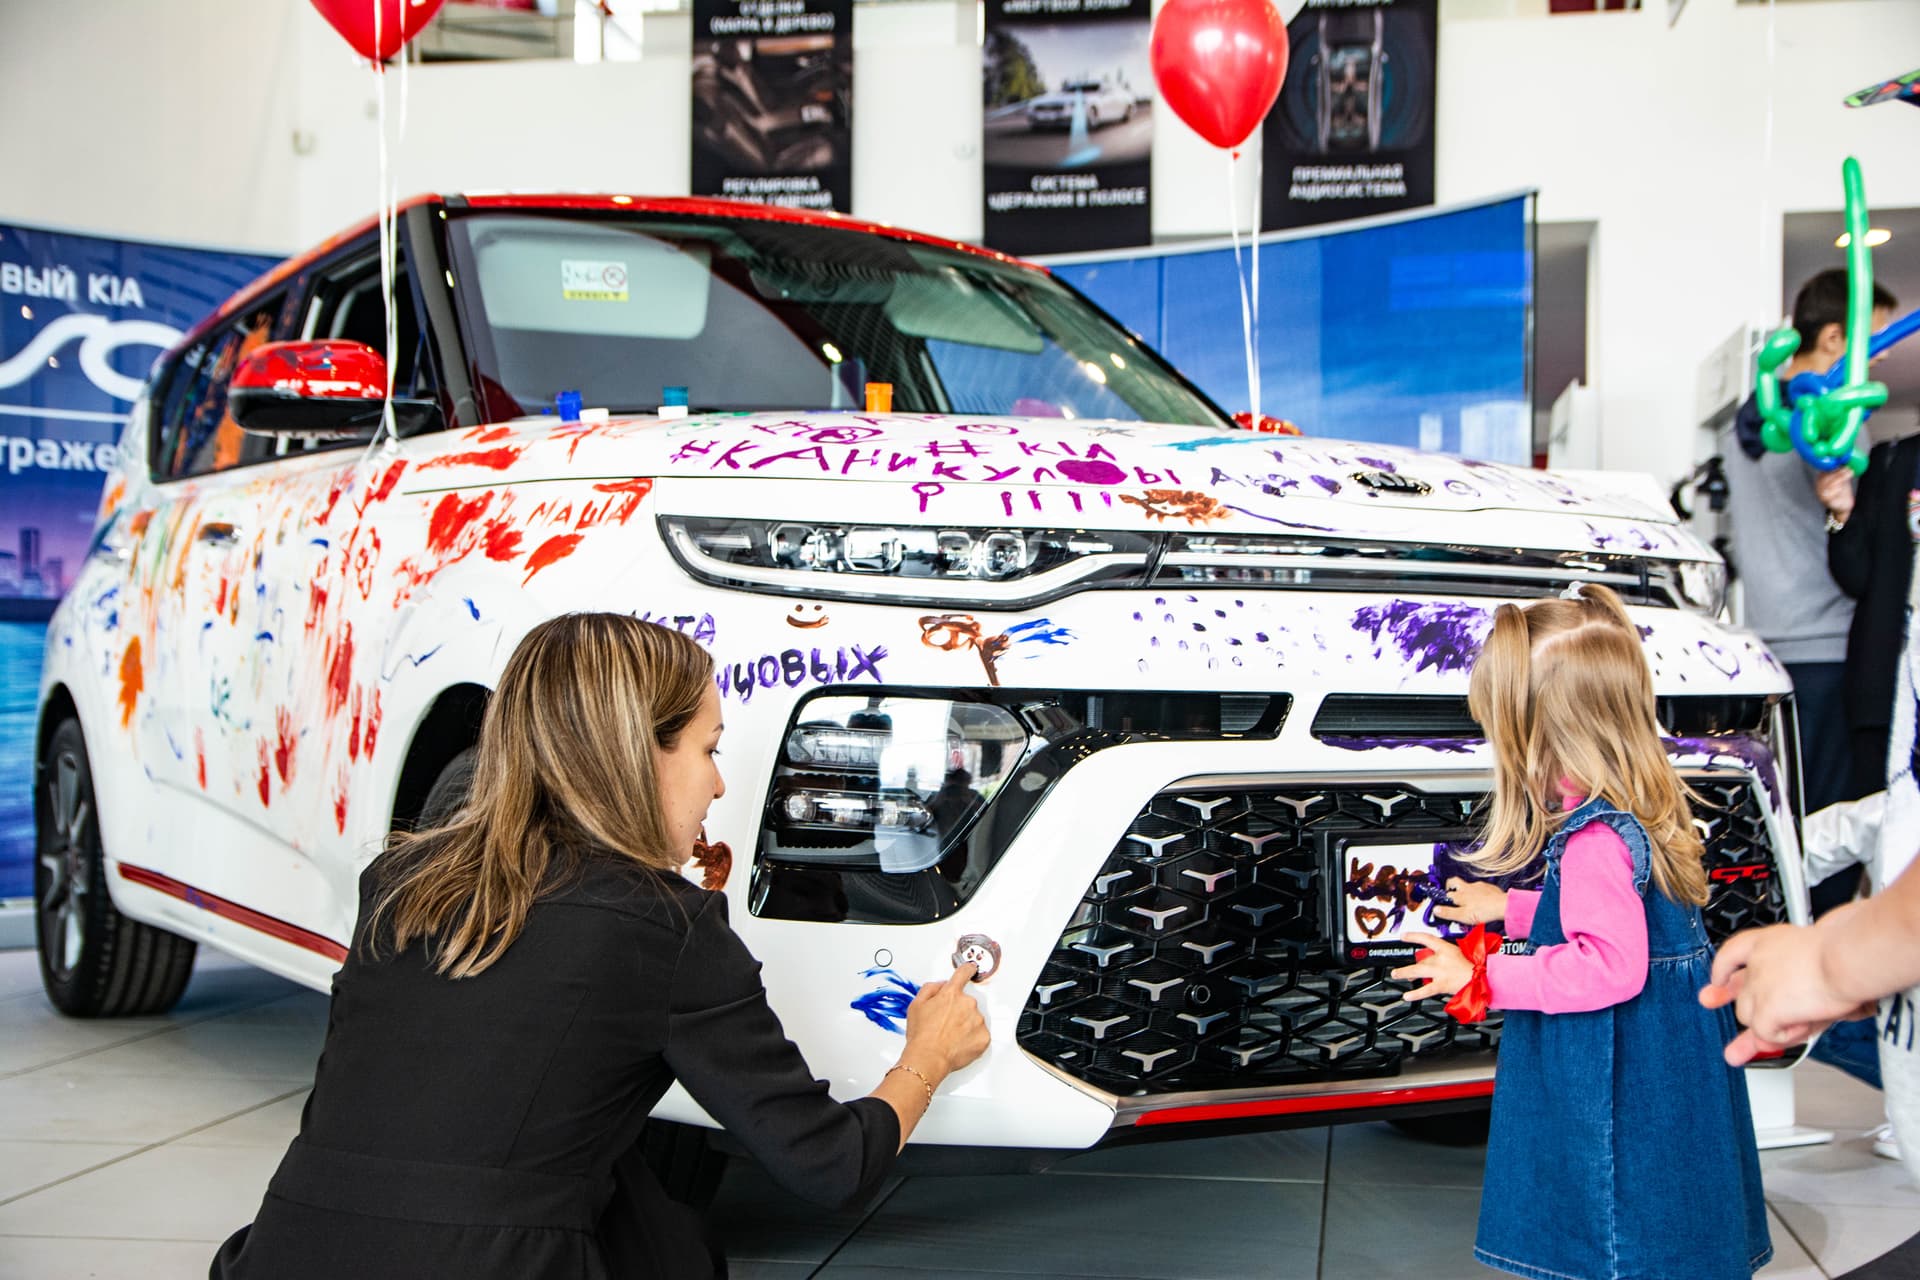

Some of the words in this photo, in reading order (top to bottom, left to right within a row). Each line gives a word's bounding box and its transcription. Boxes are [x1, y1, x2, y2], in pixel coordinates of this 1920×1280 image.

[1292, 163, 1403, 182] ПРЕМИАЛЬНАЯ
[723, 175, 819, 193] РЕГУЛИРОВКА
[1031, 174, 1099, 192] СИСТЕМА
[1288, 181, 1407, 202] АУДИОСИСТЕМА
[988, 191, 1074, 211] УДЕРЖАНИЯ
[1076, 191, 1087, 208] В
[1089, 187, 1147, 207] ПОЛОСЕ
[1, 261, 77, 301] ВЫЙ
[87, 272, 144, 308] KIA
